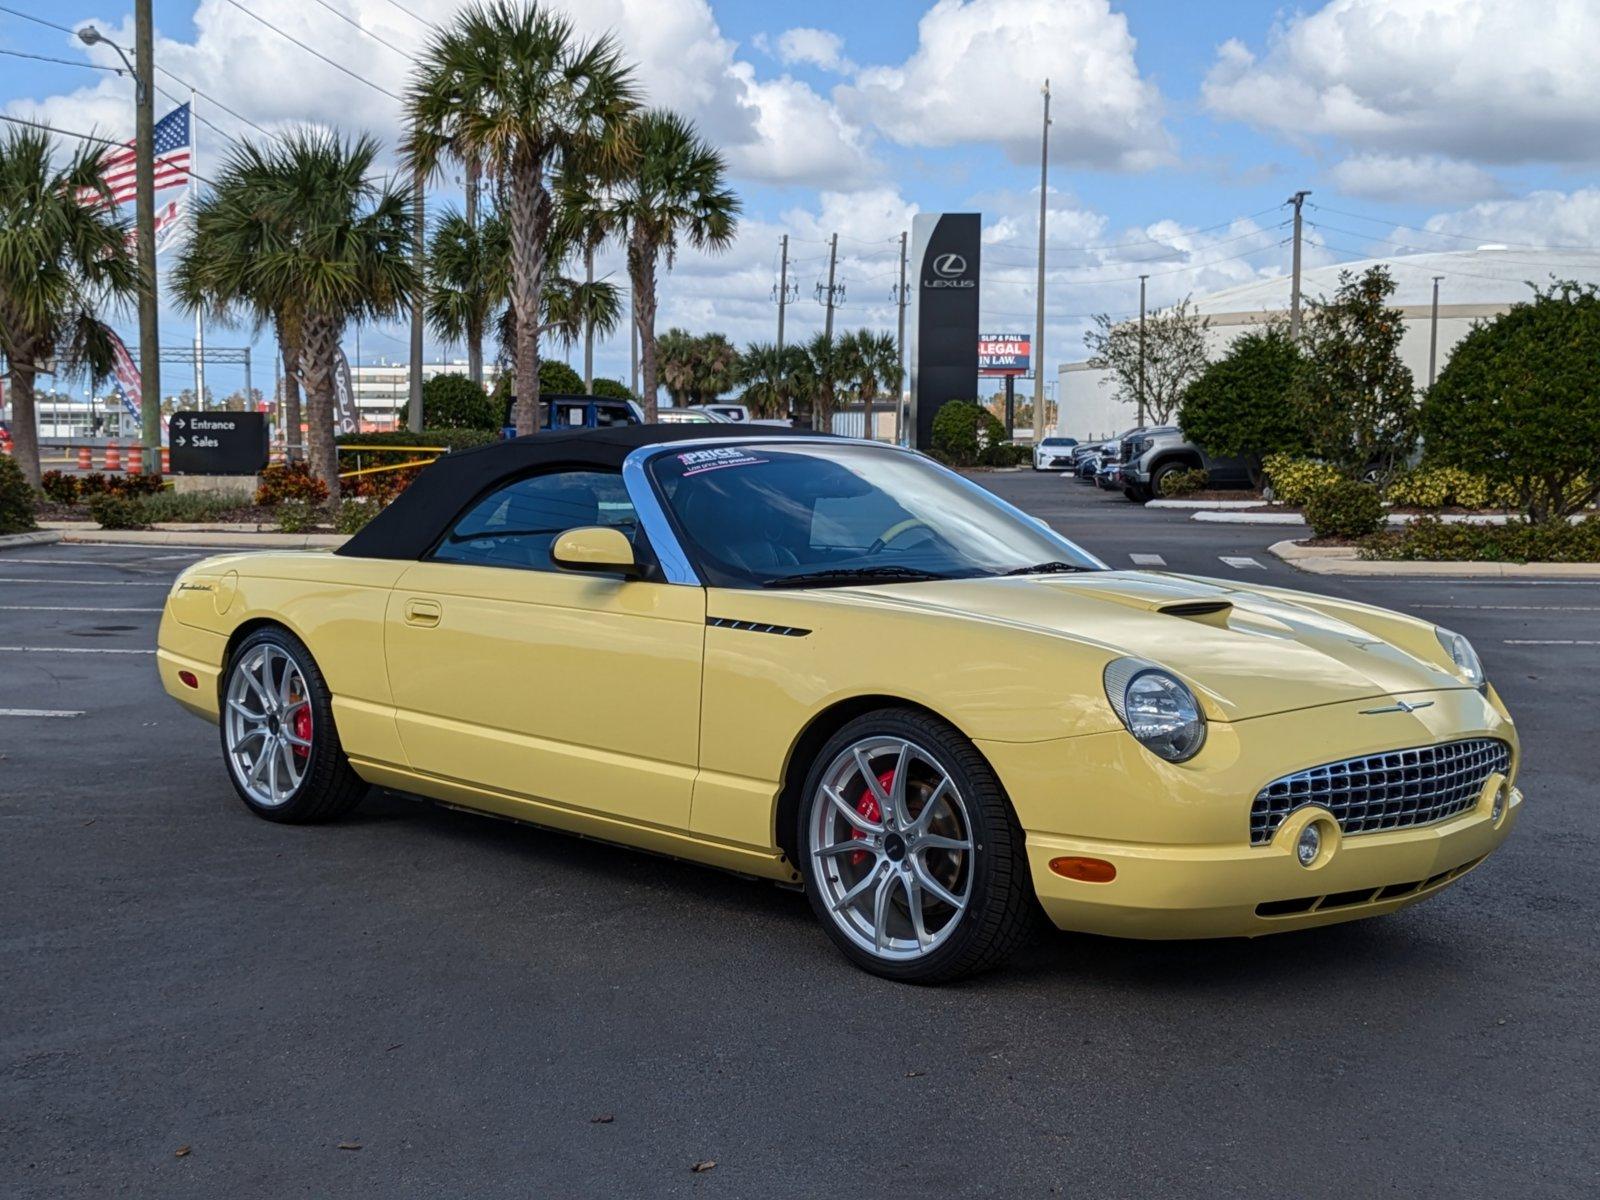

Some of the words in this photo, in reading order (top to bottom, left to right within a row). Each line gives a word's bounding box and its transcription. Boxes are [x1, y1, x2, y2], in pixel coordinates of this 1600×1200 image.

[980, 343, 1022, 355] LEGAL
[992, 356, 1016, 365] LAW.
[190, 418, 236, 430] Entrance
[191, 435, 219, 447] Sales
